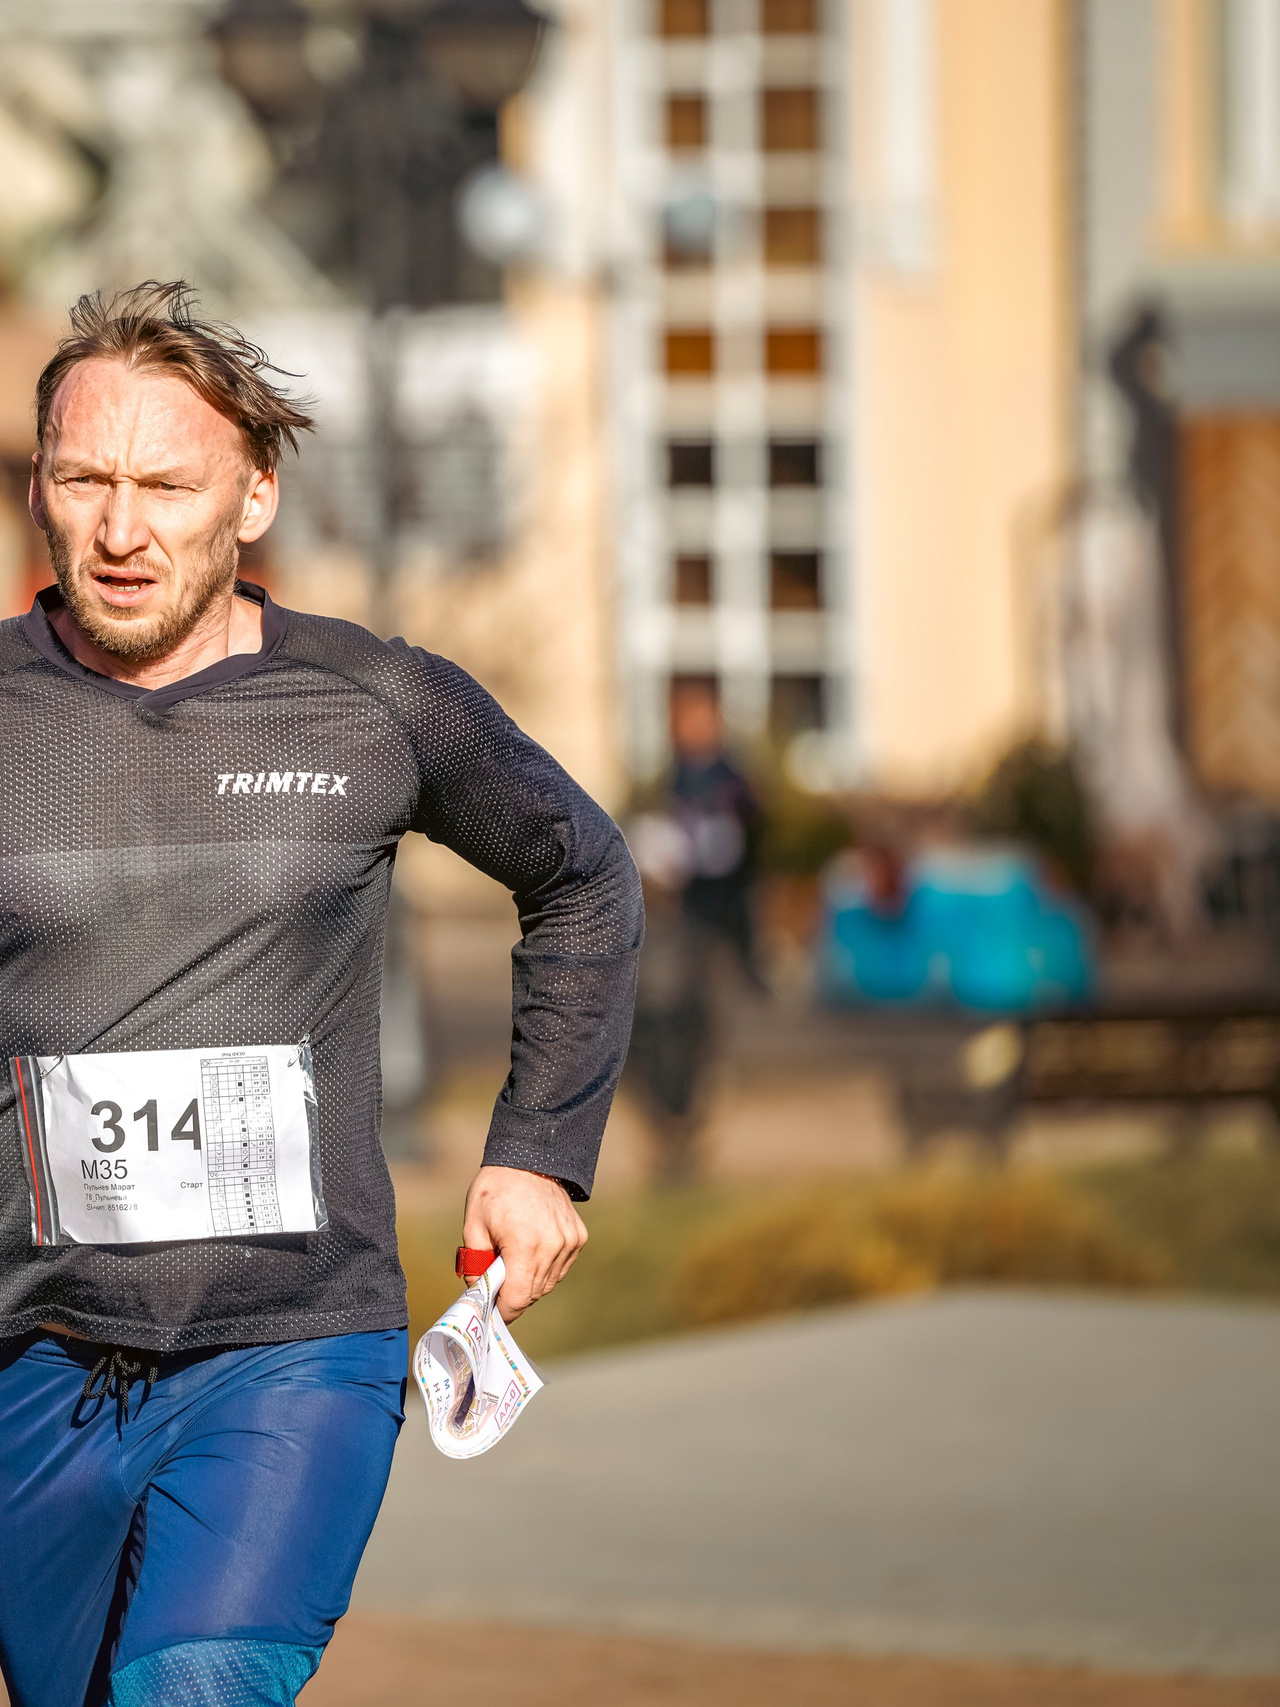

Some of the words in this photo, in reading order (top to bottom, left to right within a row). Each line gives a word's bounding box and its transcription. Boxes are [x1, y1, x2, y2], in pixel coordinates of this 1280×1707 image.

[217, 772, 349, 795] TRIMTEX
[90, 1098, 201, 1153] 314
[80, 1159, 128, 1180] M35
